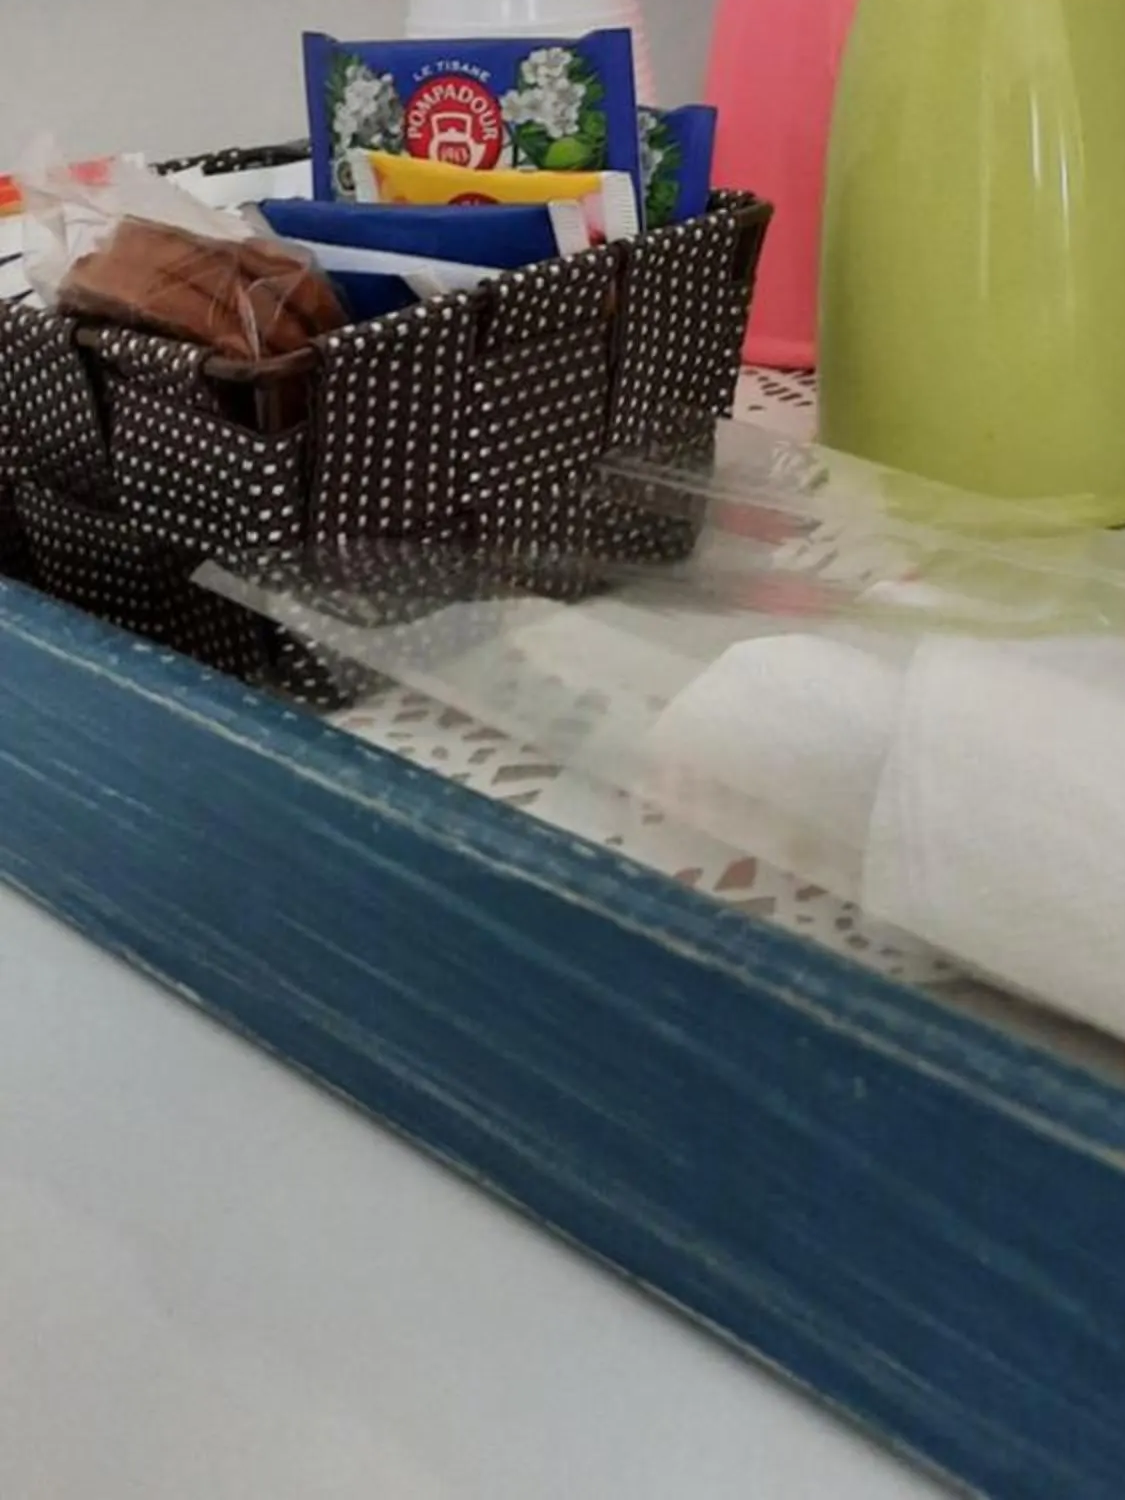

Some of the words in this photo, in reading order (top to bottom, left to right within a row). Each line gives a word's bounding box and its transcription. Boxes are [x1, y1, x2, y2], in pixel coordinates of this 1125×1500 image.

[412, 65, 432, 82] LE
[436, 60, 491, 82] TISANE
[407, 84, 498, 141] POMPADOUR
